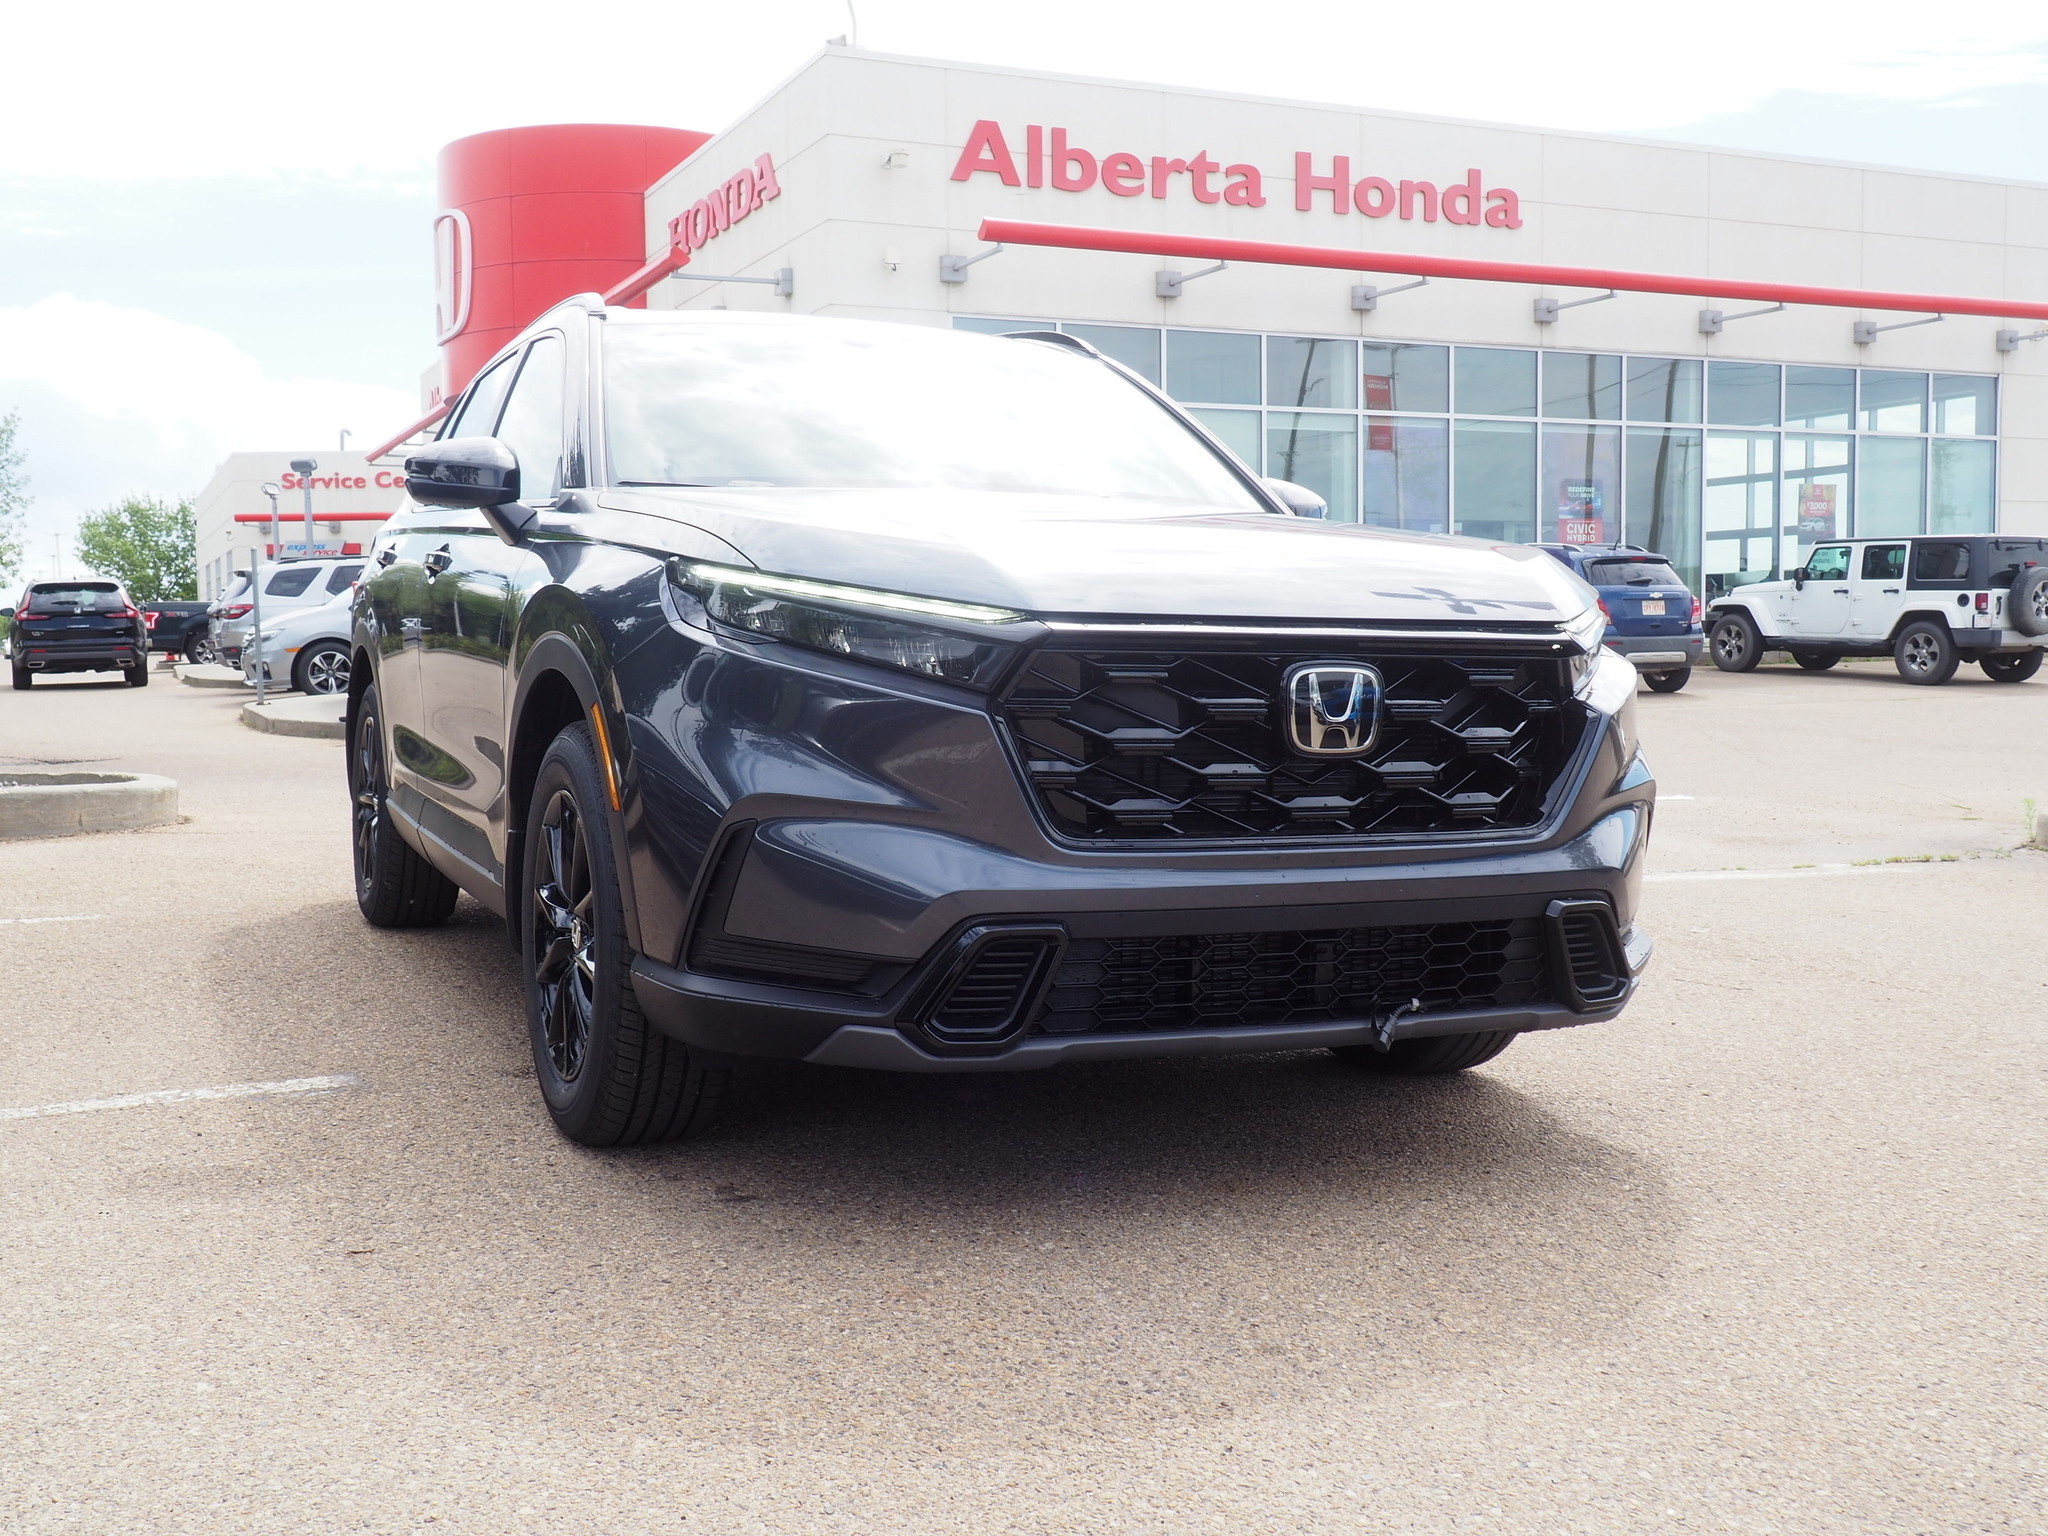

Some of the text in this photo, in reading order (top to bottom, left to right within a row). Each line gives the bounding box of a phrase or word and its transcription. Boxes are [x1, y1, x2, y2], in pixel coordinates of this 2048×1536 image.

[950, 119, 1523, 230] Alberta Honda
[668, 152, 781, 255] HONDA
[281, 472, 366, 489] Service
[1566, 523, 1596, 535] CIVIC
[1566, 534, 1596, 542] HYBRID
[287, 544, 326, 552] expss
